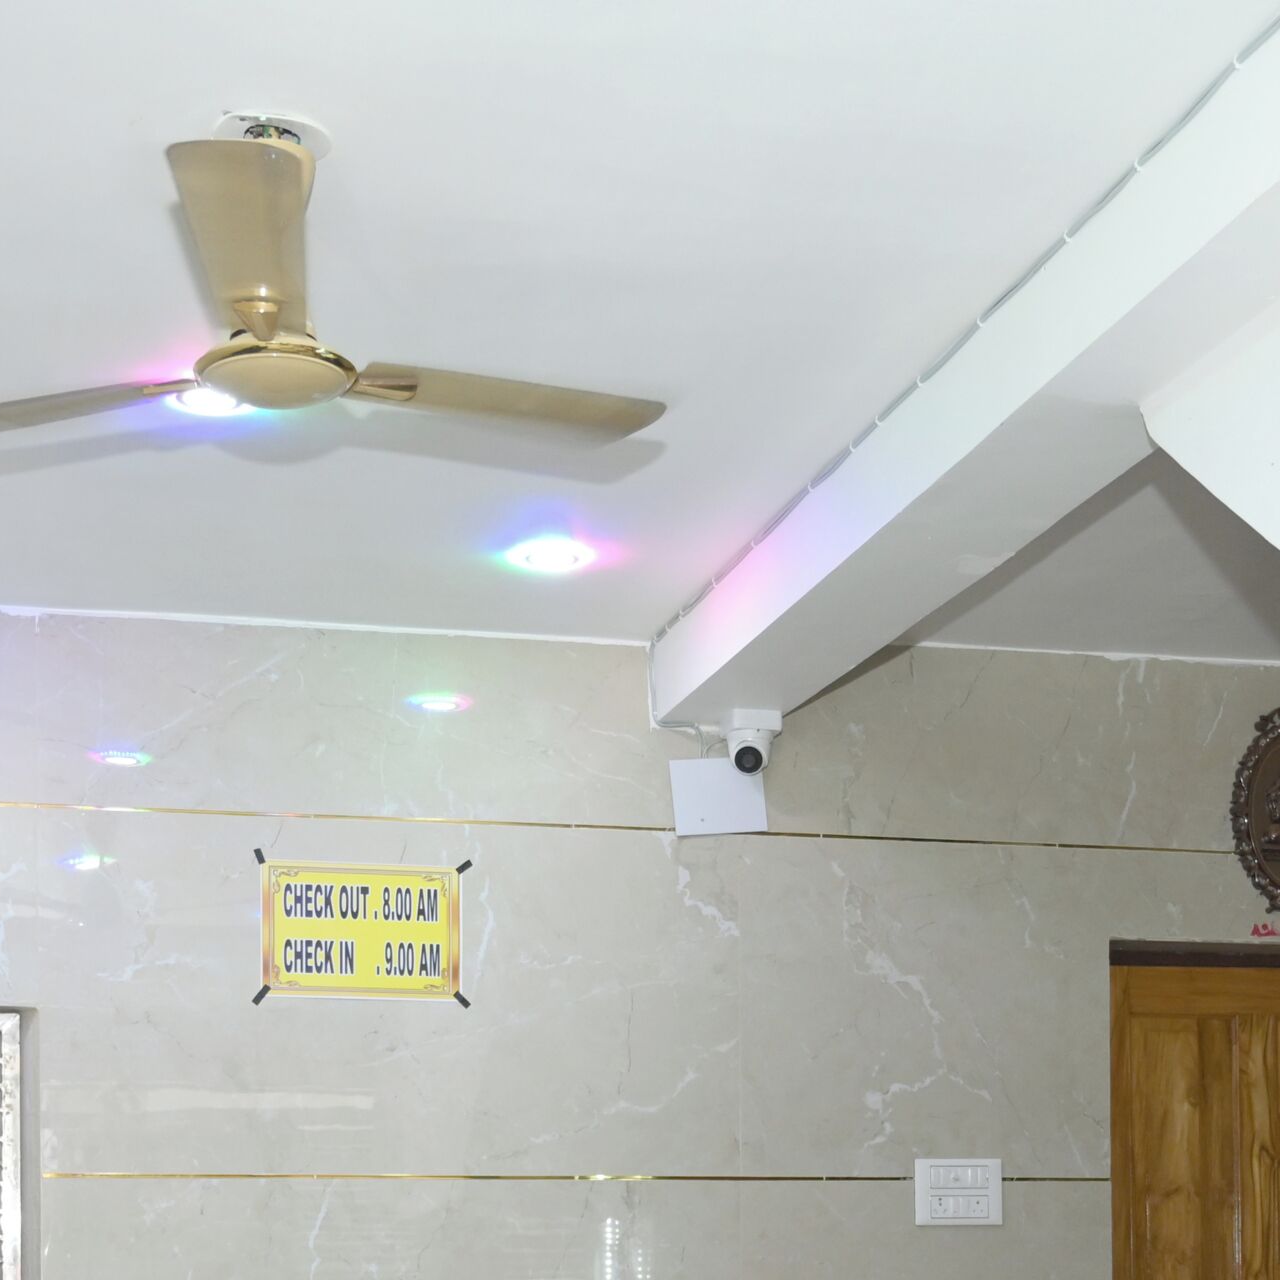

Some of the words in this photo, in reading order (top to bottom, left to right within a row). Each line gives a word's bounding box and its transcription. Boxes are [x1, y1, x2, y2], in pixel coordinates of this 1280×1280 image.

[283, 883, 335, 919] CHECK
[339, 885, 370, 920] OUT
[382, 887, 412, 922] 8.00
[416, 888, 439, 922] AM
[283, 939, 335, 975] CHECK
[339, 940, 355, 975] IN
[384, 942, 415, 976] 9.00
[419, 943, 441, 977] AM
